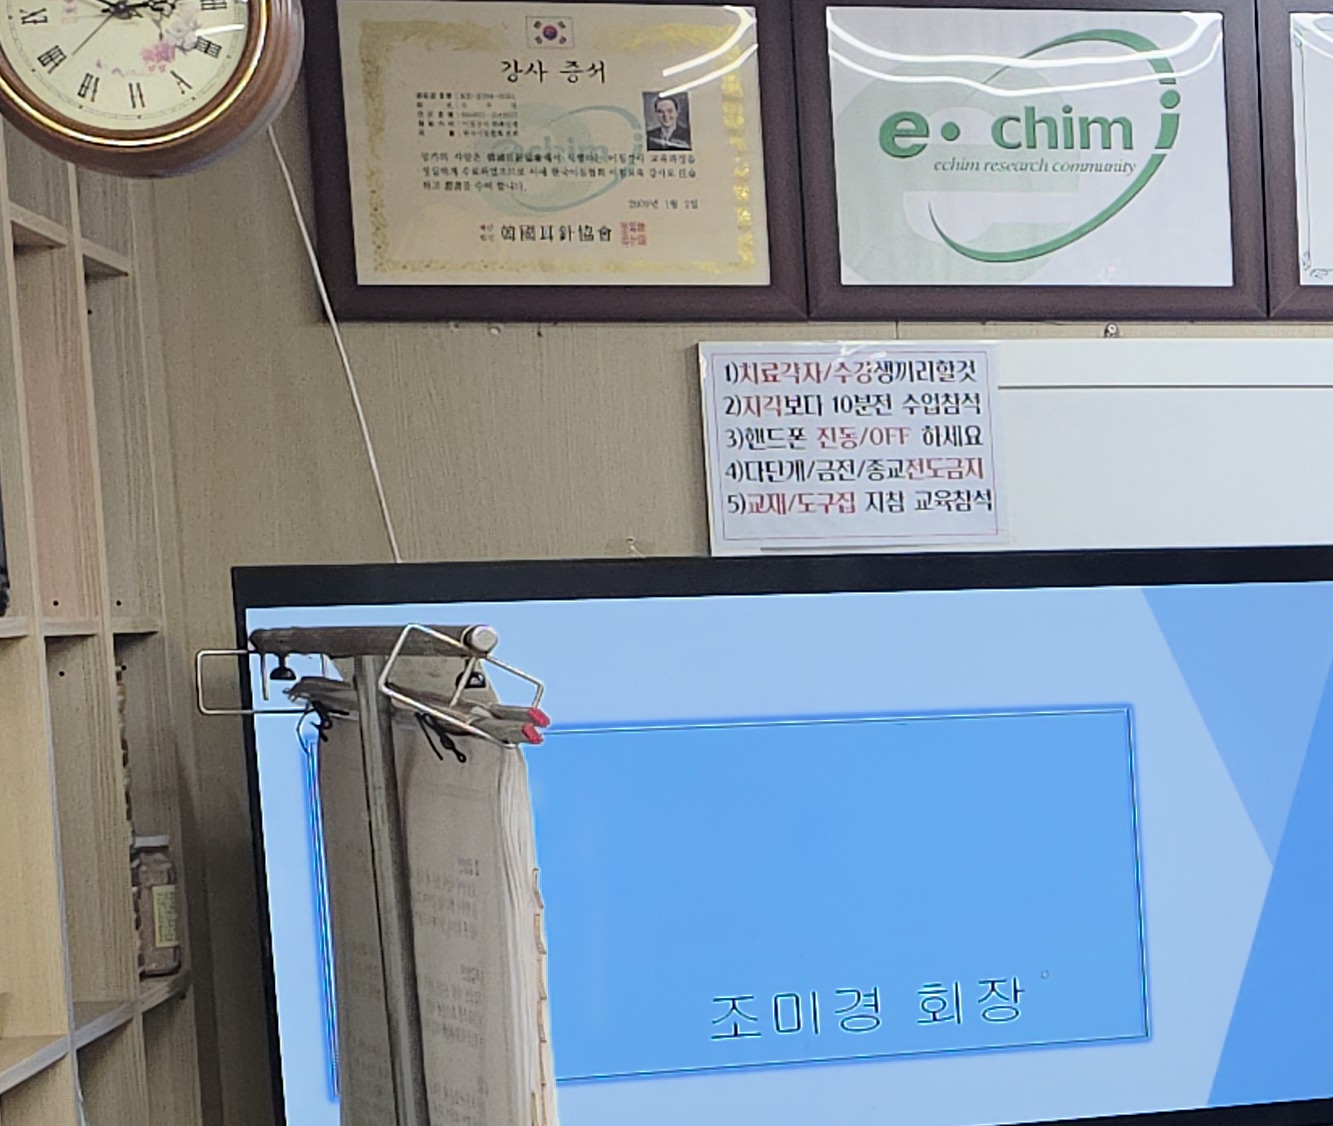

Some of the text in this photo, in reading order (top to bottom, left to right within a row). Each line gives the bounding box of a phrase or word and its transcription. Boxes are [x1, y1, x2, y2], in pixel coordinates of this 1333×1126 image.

[501, 59, 606, 83] 강사 증서
[990, 104, 1134, 151] chim
[933, 157, 1137, 177] echim research community
[832, 393, 892, 417] 10분전
[725, 425, 984, 450] 3)핸드폰 진동/OFF 하세요
[724, 457, 985, 483] 4)다단계/금전/종교전도금지
[709, 975, 1026, 1041] 조미경 회장
